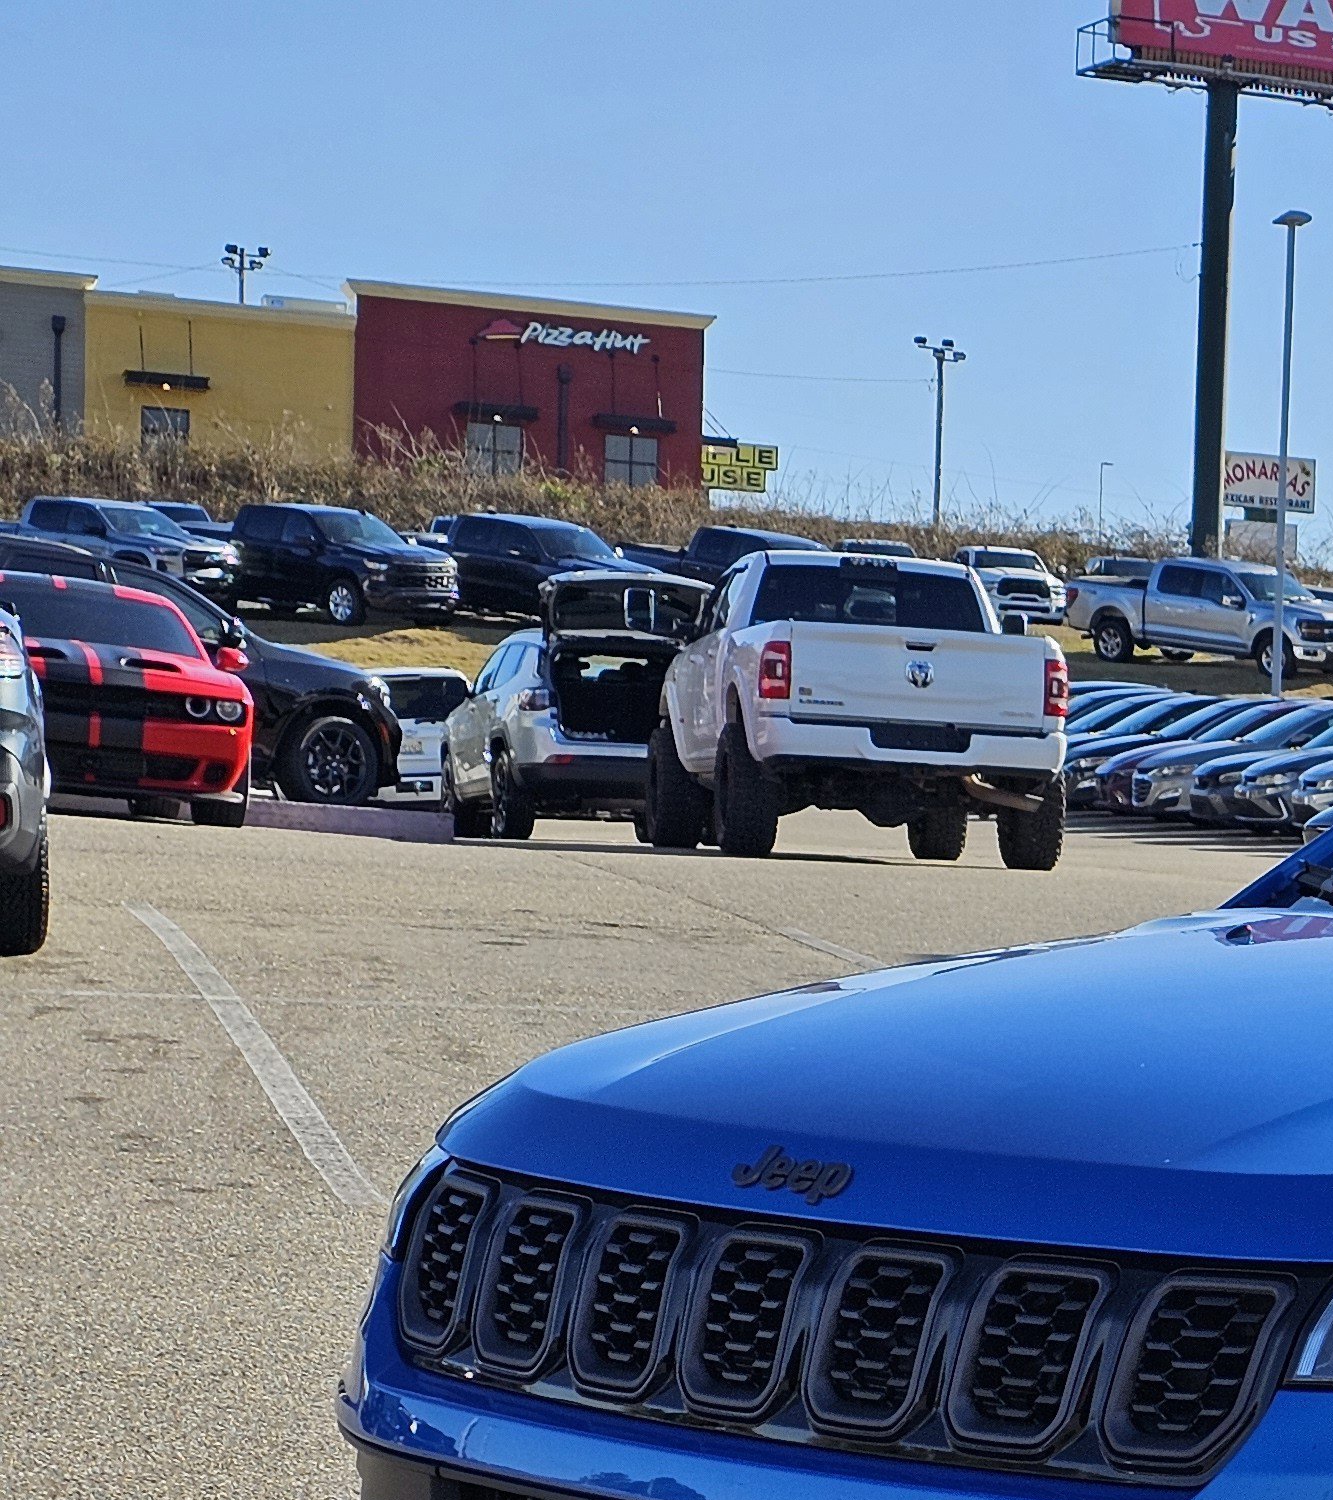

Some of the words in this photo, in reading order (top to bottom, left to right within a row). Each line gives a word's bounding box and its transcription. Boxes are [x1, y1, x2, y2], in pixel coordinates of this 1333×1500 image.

[1254, 24, 1318, 49] US
[521, 322, 595, 347] Pizza
[594, 328, 651, 354] Hut
[1224, 459, 1311, 498] MONARAS
[1224, 491, 1256, 505] EXICAN
[1259, 494, 1311, 509] RESTRANT
[731, 1144, 855, 1206] Jeep
